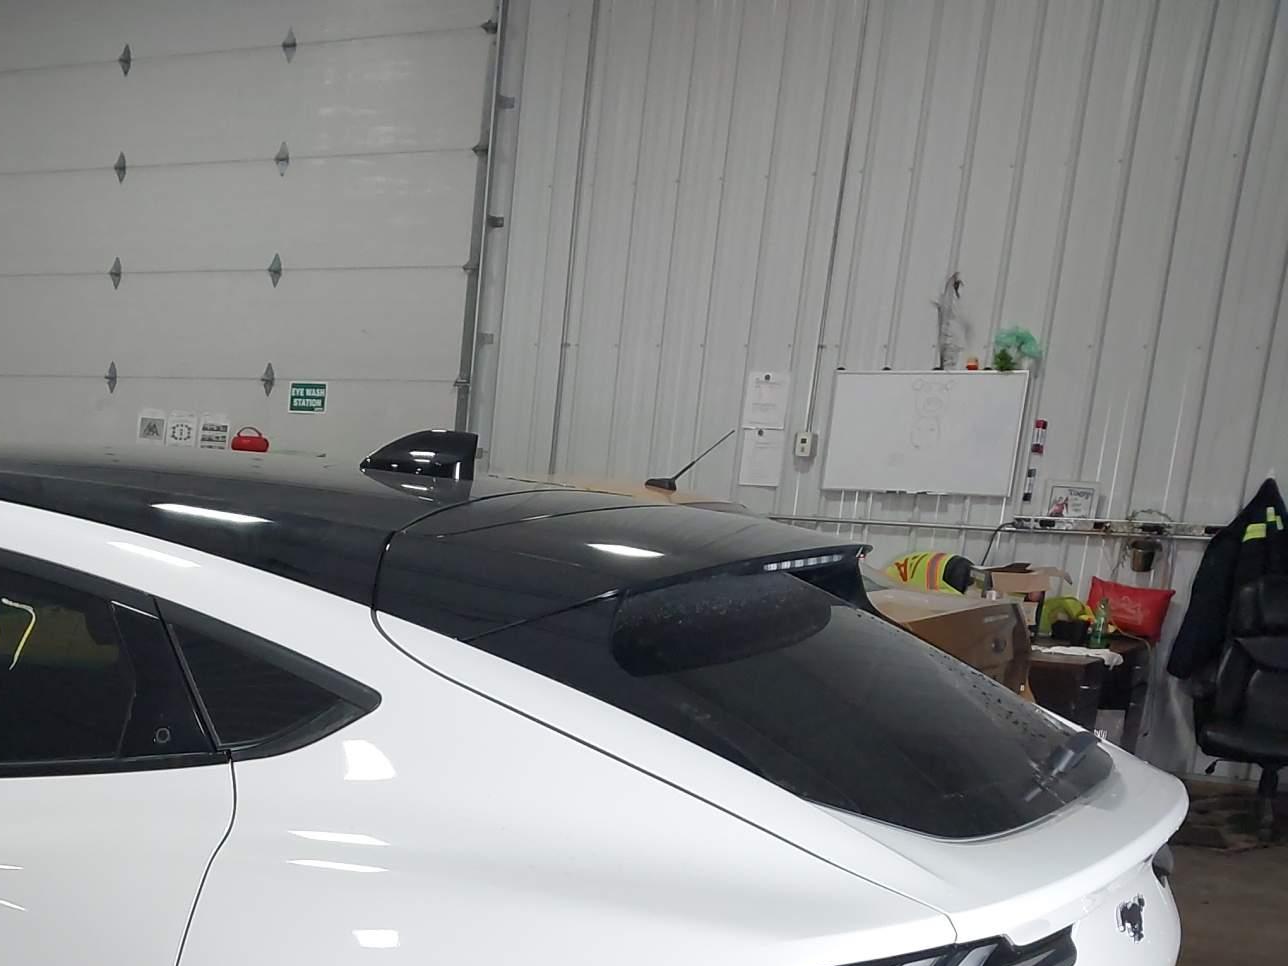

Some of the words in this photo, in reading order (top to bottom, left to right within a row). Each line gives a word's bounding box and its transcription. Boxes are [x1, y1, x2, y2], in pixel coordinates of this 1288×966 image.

[291, 387, 305, 397] EYE
[305, 388, 325, 397] WASH
[292, 398, 322, 407] STATION
